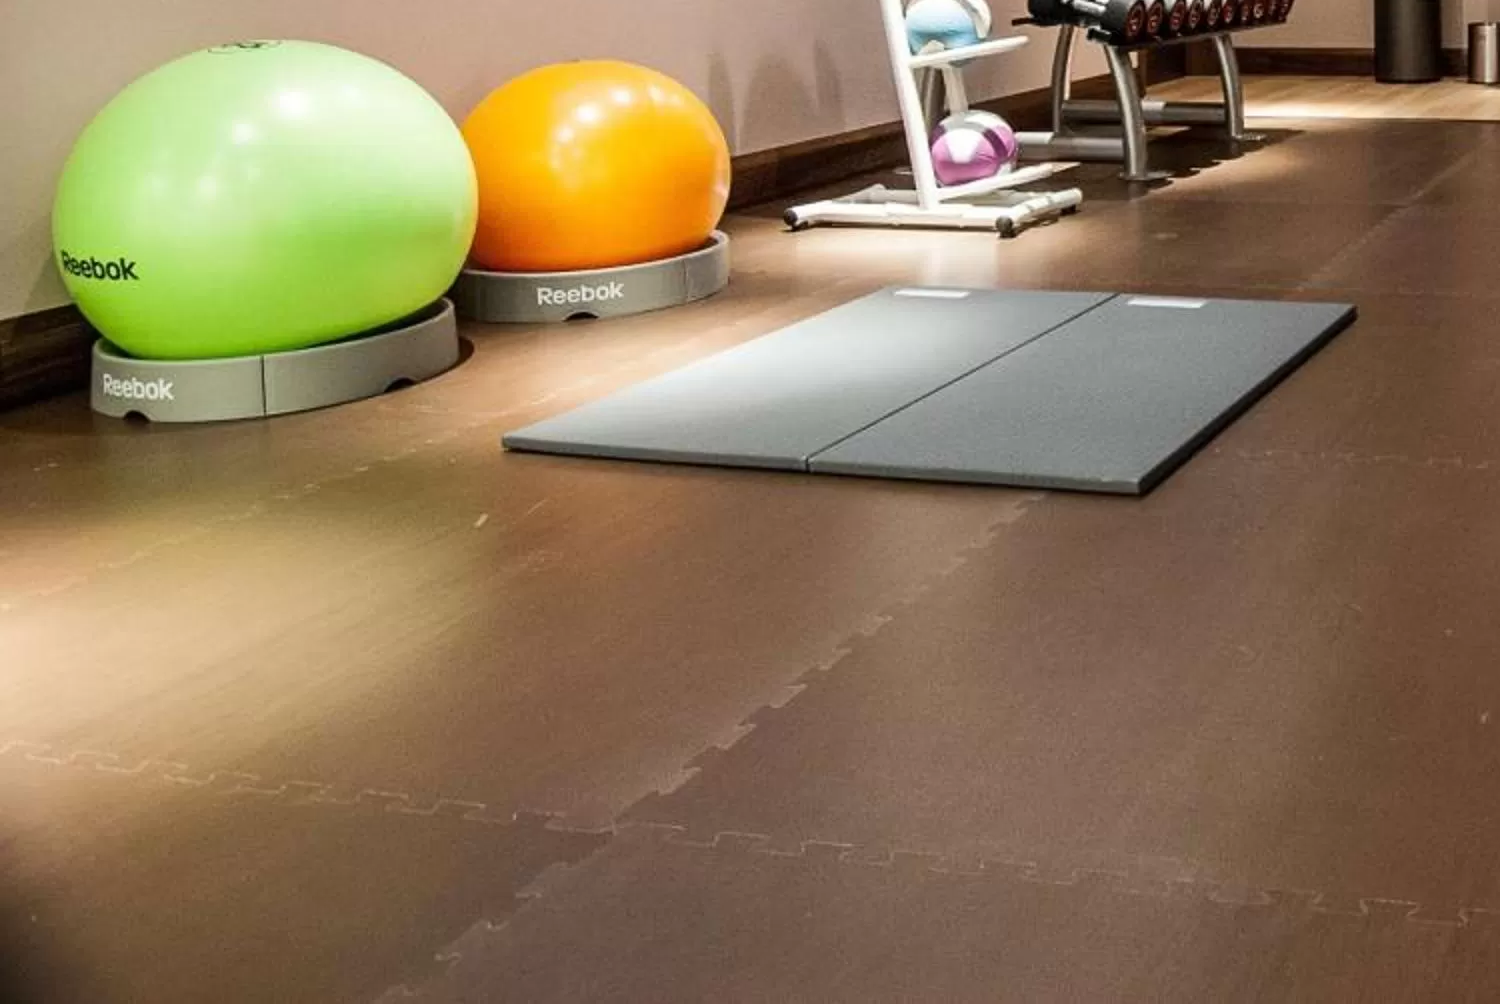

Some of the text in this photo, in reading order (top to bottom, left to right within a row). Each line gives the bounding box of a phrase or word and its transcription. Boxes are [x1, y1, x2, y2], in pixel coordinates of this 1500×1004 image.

[60, 249, 140, 281] Reebok
[536, 281, 625, 306] Reebok
[102, 373, 175, 401] Reebok
